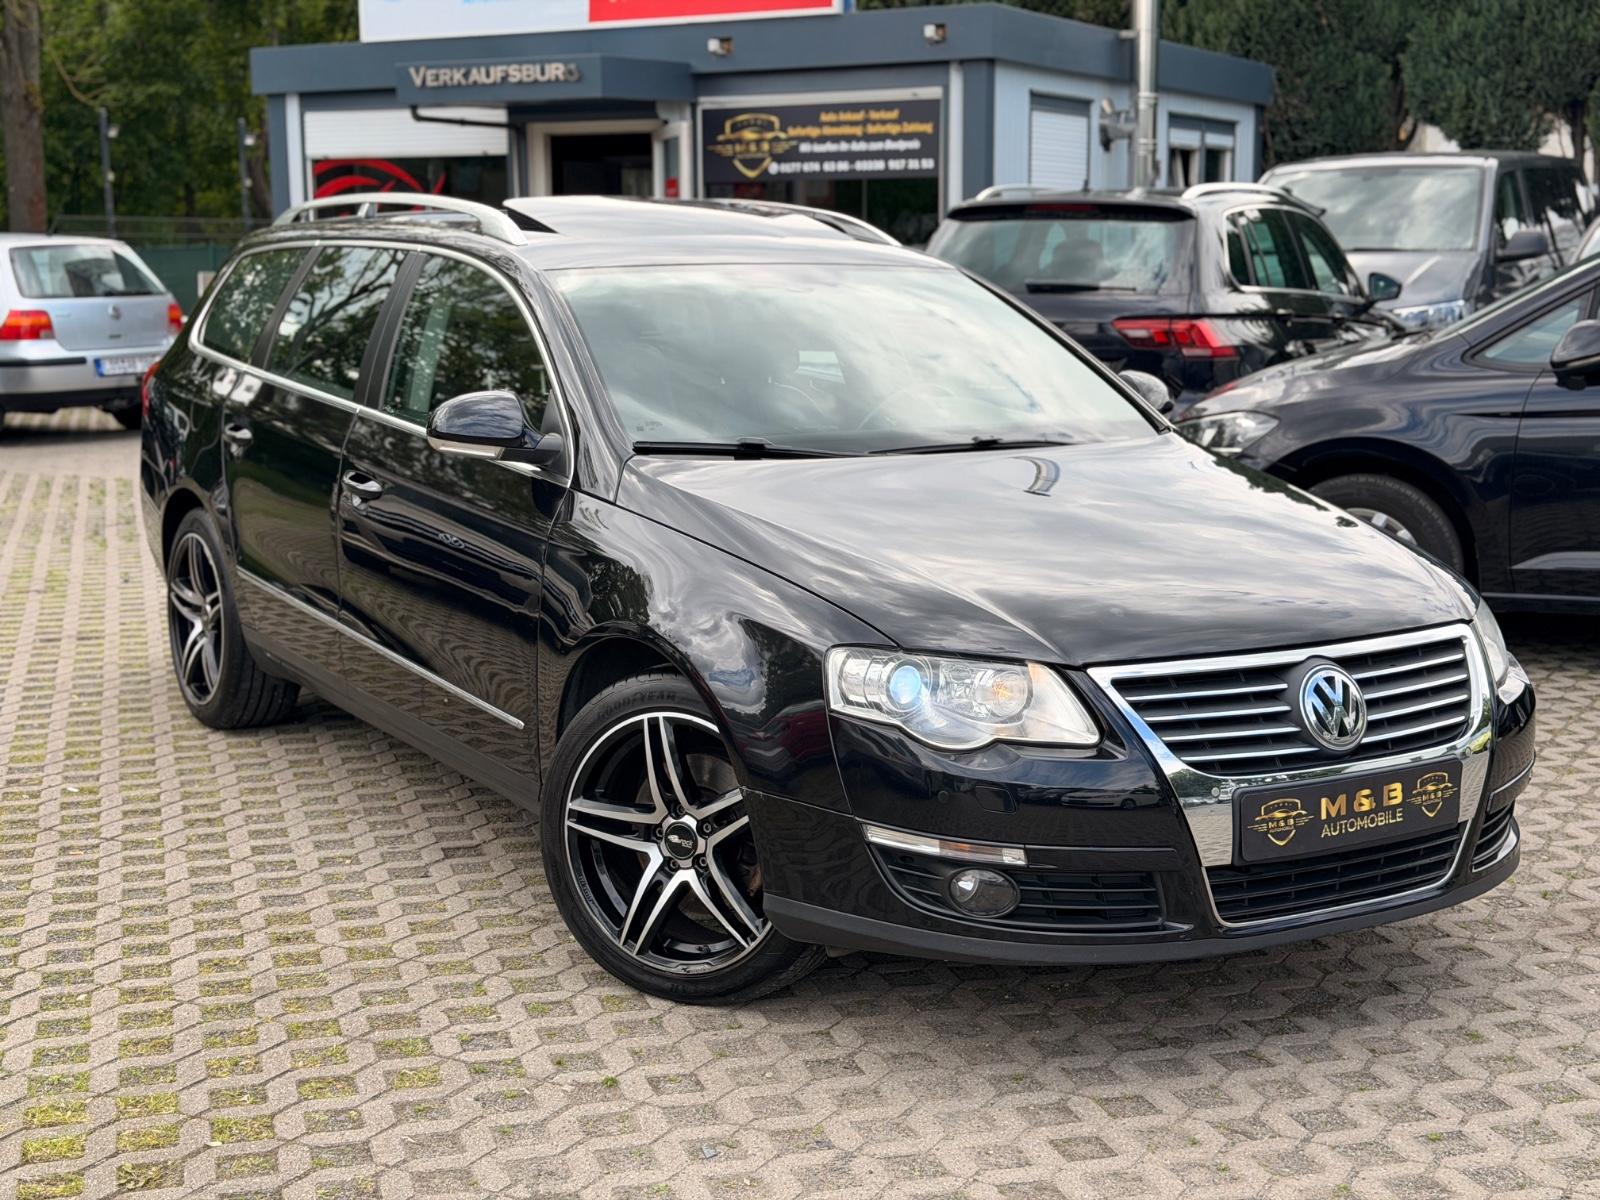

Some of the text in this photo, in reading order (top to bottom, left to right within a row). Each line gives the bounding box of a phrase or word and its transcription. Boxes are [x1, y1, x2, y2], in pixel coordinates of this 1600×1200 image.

[1320, 782, 1403, 820] M & B
[1268, 821, 1278, 829] M
[1321, 808, 1404, 838] AUTOMOBILE
